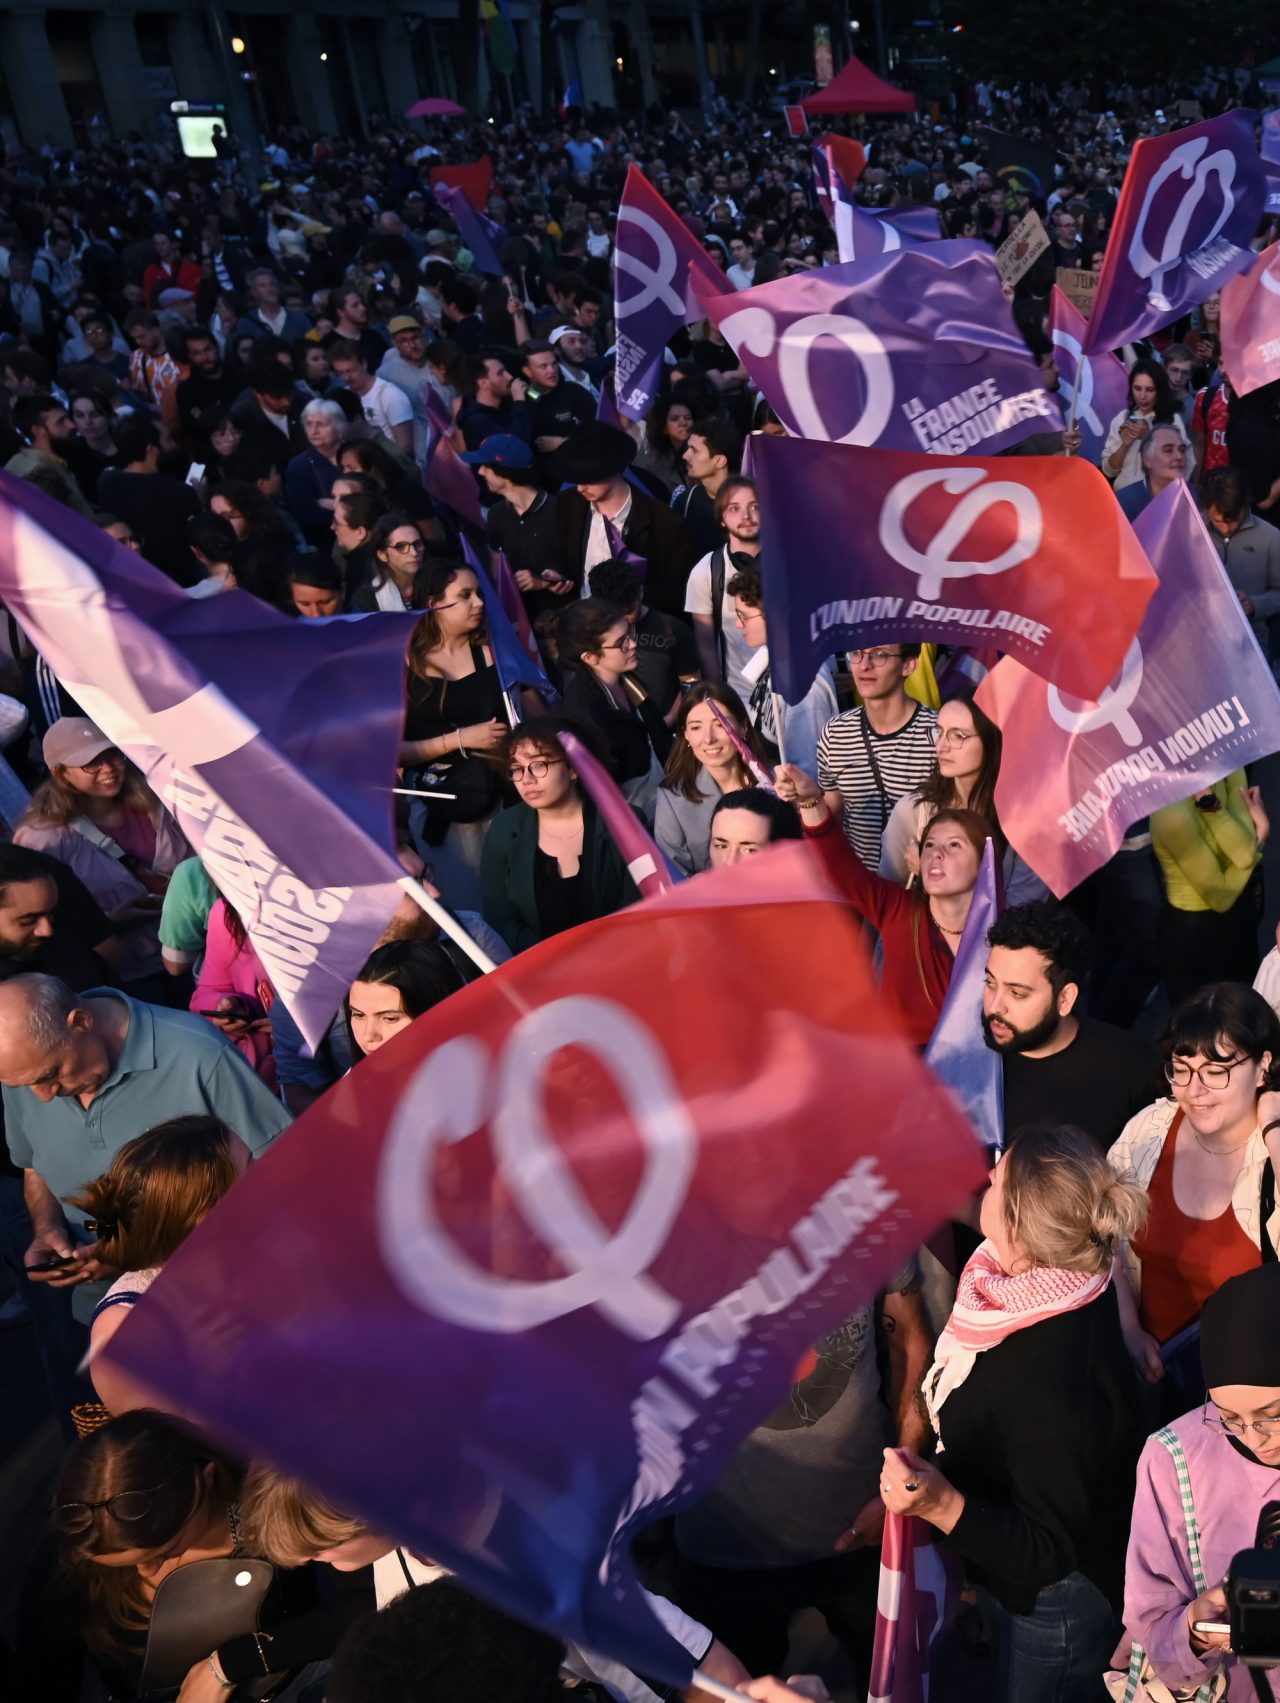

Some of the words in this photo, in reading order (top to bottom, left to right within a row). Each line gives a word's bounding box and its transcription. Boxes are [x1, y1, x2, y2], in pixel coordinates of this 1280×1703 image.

[902, 397, 927, 421] LA
[910, 378, 1003, 450] FRANCE
[809, 597, 904, 642] L'UNION
[905, 600, 1052, 646] POPULAIRE
